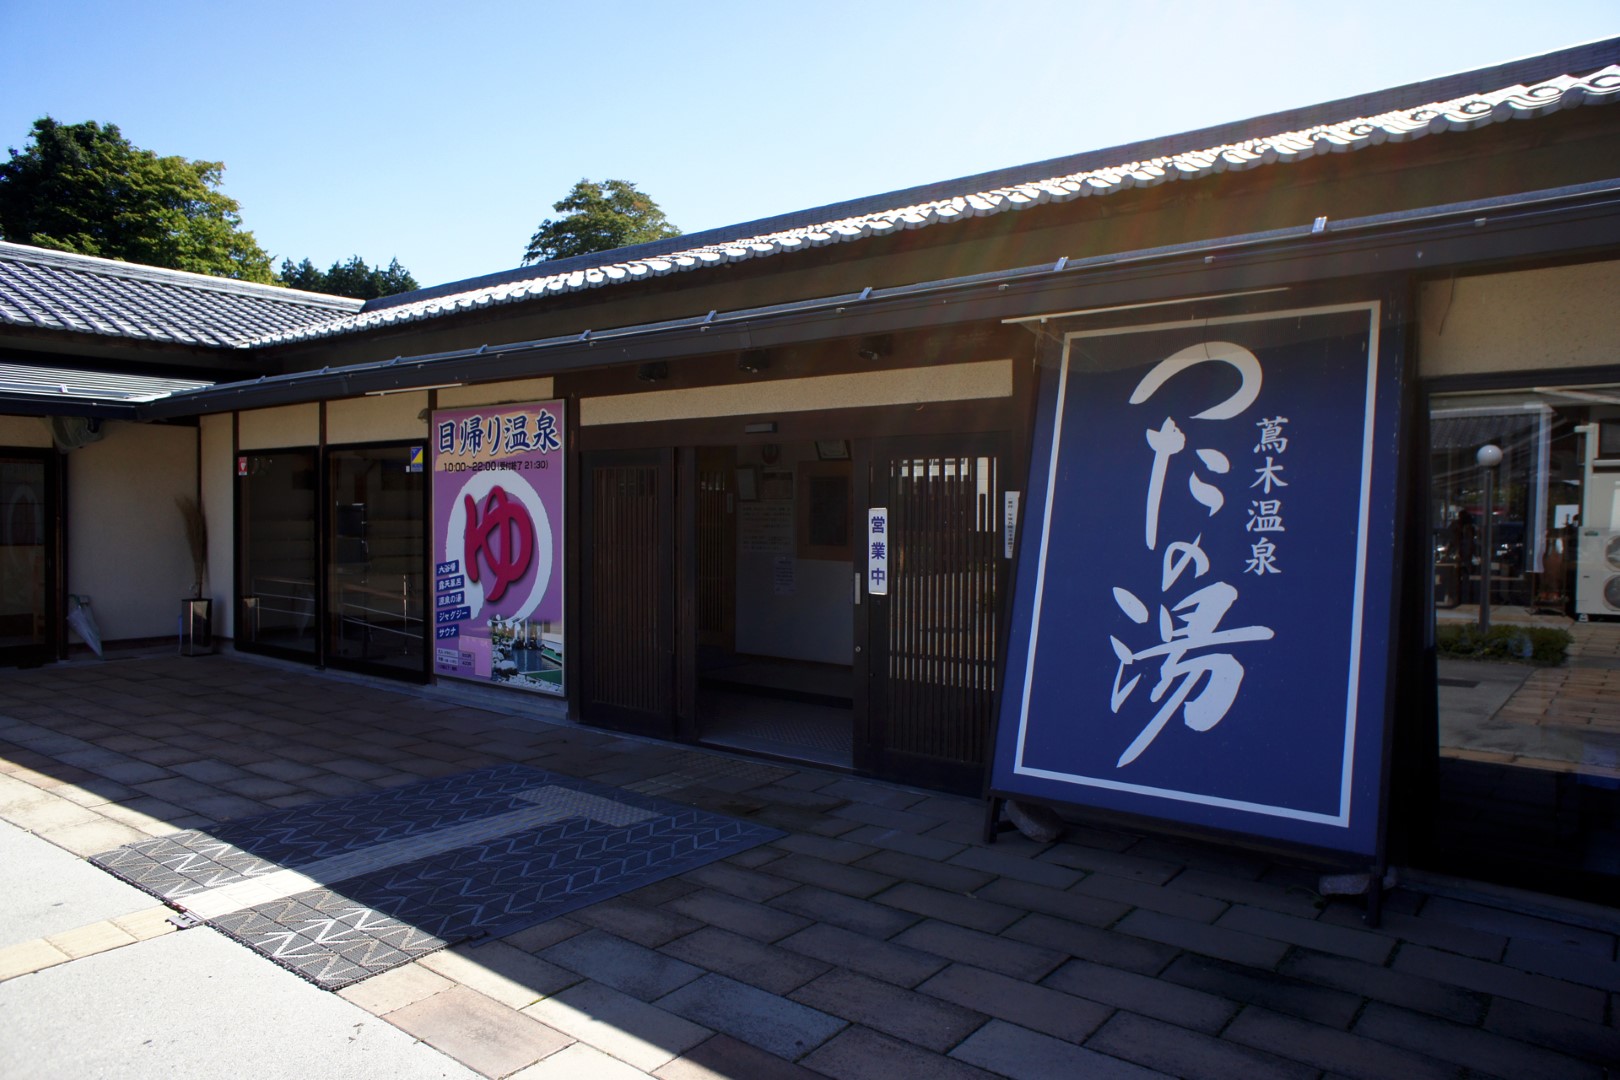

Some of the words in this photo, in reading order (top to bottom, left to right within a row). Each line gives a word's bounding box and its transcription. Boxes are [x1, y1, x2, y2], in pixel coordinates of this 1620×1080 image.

[438, 408, 561, 457] 日帰り温泉
[1243, 416, 1288, 576] 蔦木温泉
[464, 485, 532, 602] ゆ
[870, 516, 886, 586] 営業中
[1110, 341, 1274, 768] つたの湯
[439, 626, 456, 638] サウナ
